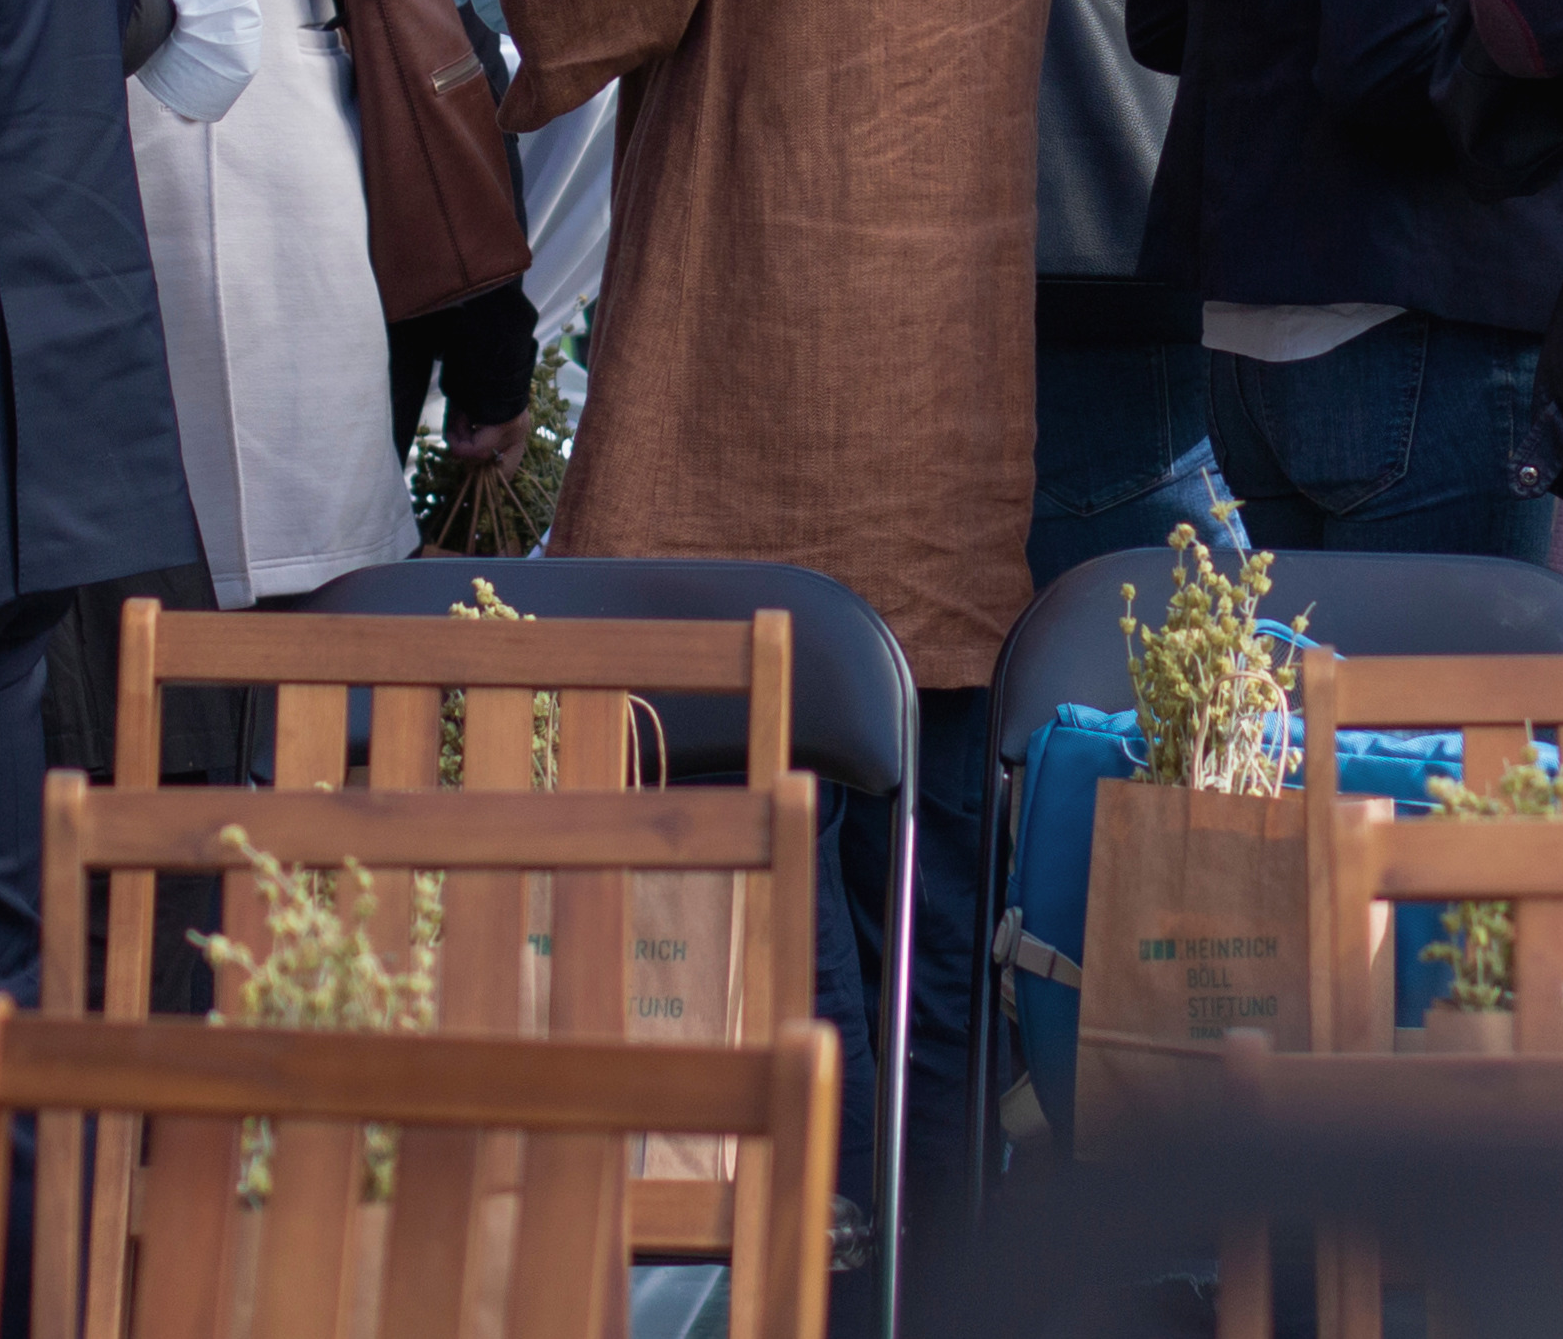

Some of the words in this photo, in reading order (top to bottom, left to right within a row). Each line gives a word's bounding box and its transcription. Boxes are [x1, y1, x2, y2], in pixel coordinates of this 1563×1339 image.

[629, 938, 688, 963] RICH
[1184, 936, 1279, 961] HEINRICH
[1187, 963, 1233, 989] BÖLL
[1187, 995, 1279, 1019] STIFTUNG
